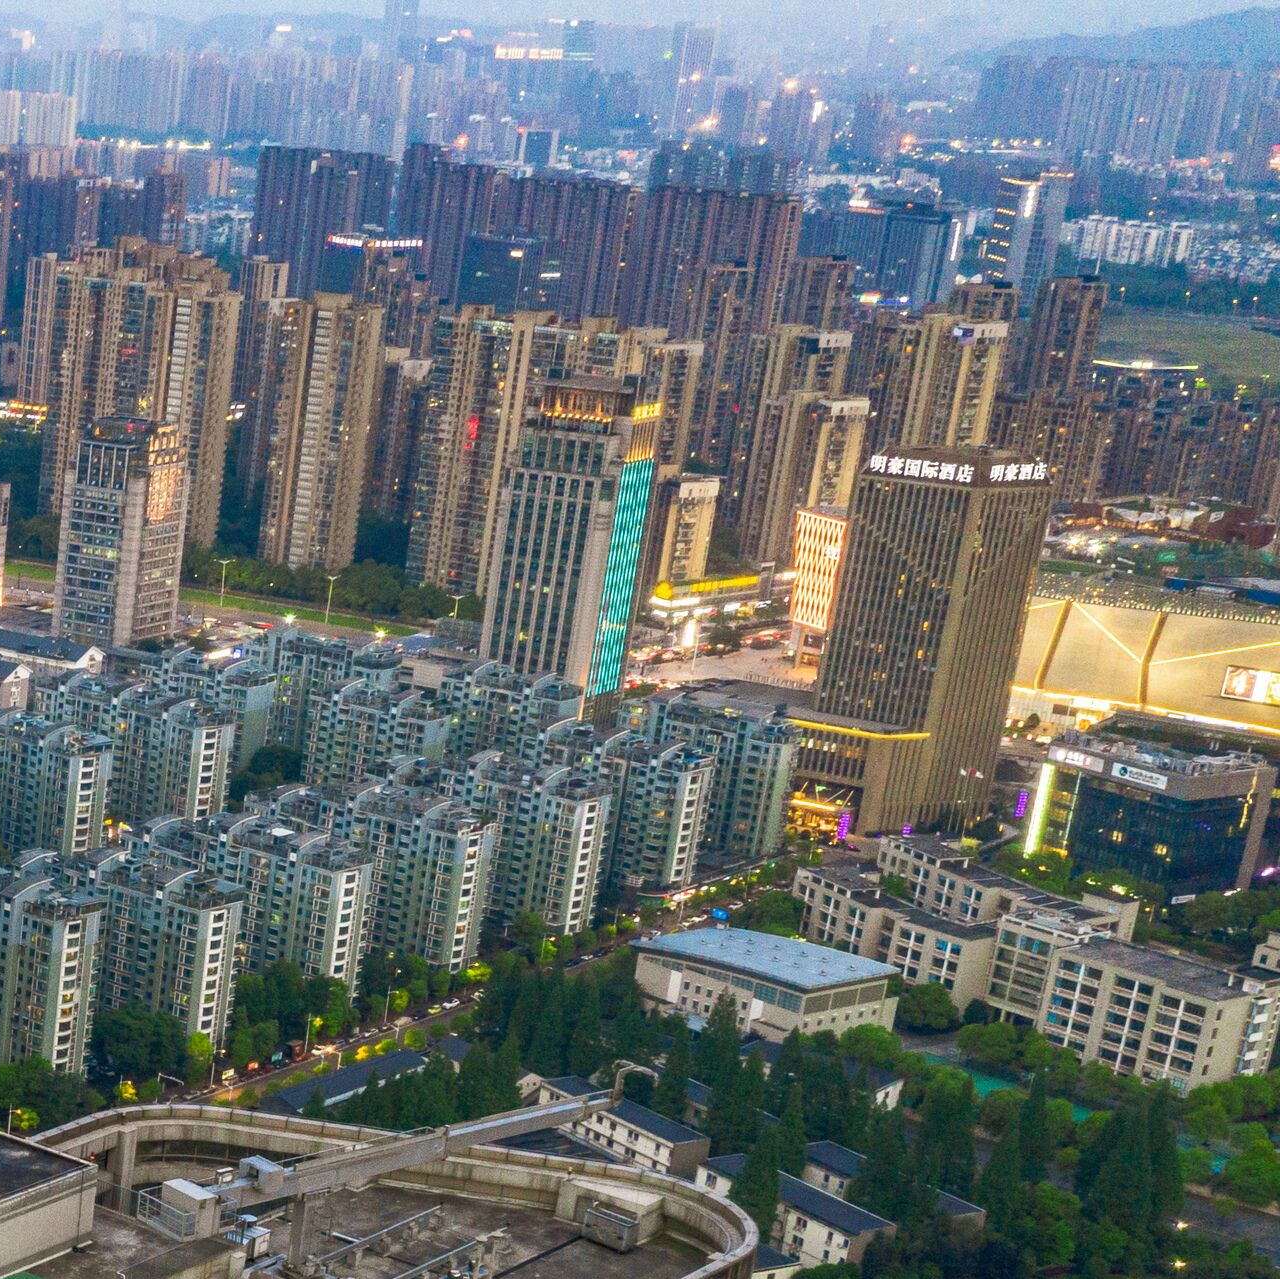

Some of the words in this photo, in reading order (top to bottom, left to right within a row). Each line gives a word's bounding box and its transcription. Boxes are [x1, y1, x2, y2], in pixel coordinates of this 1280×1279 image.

[870, 454, 975, 483] 明豪国际酒店
[990, 462, 1048, 482] 明豪酒店
